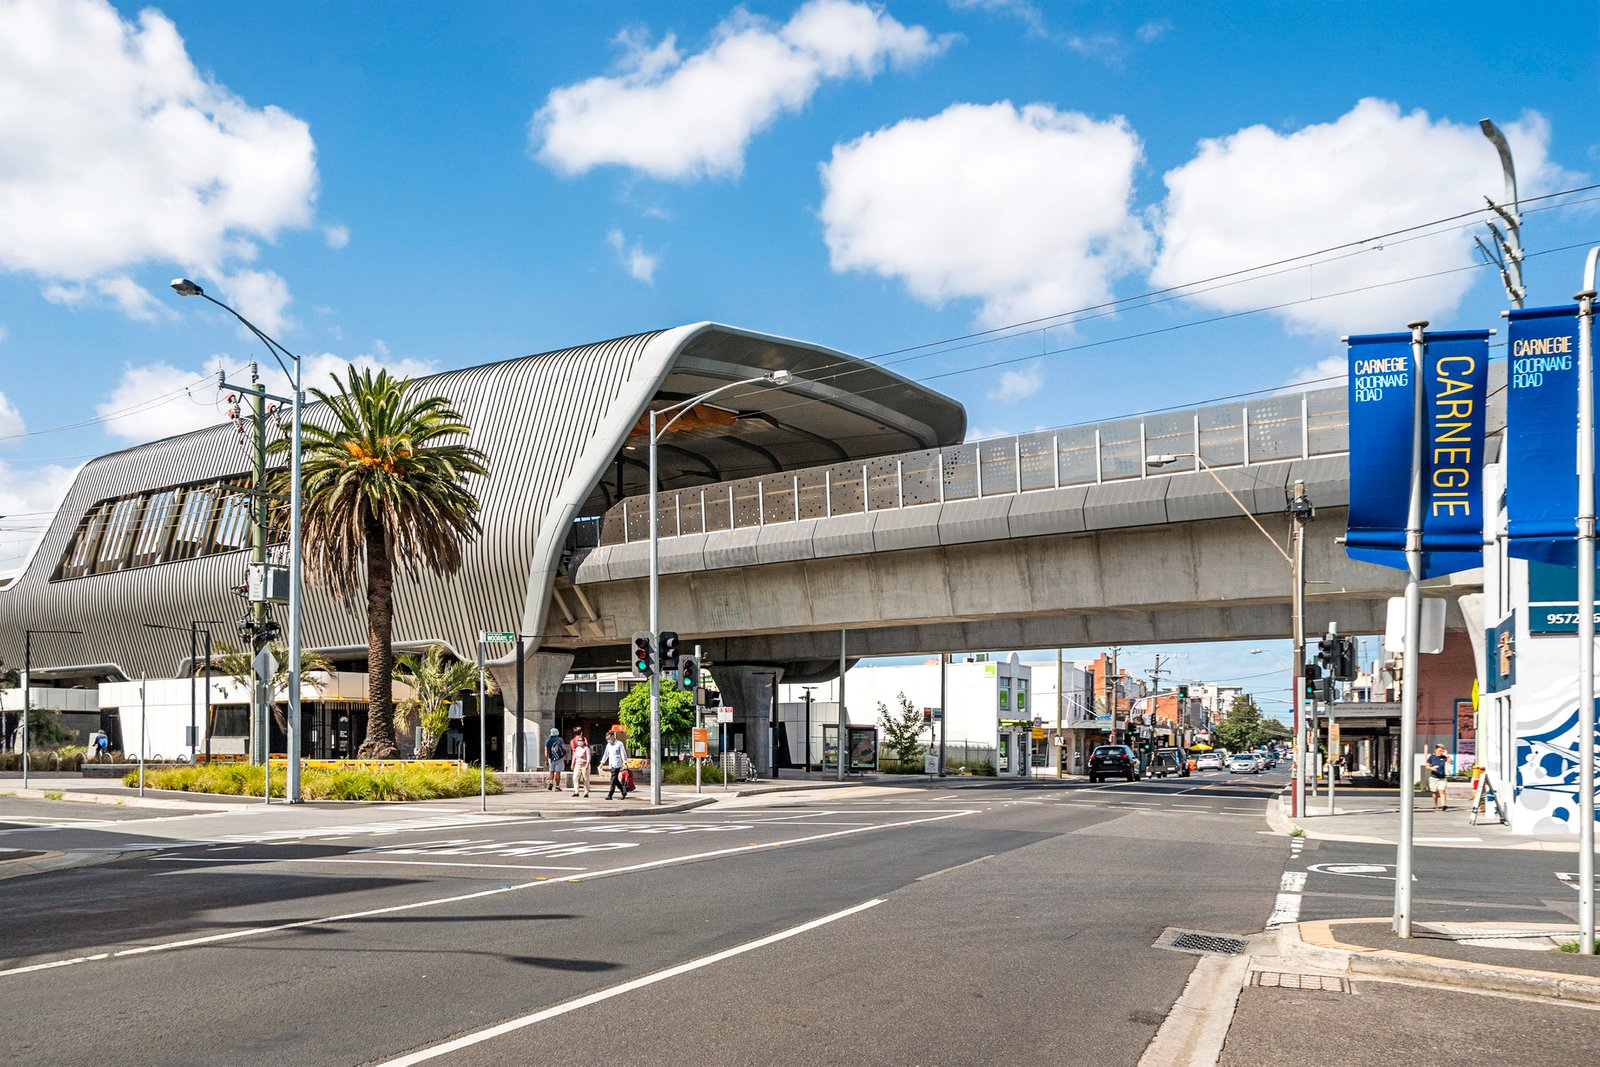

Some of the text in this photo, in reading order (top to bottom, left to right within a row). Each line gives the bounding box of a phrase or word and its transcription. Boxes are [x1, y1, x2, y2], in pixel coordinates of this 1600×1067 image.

[1513, 335, 1573, 357] CARNEGIE
[1354, 356, 1408, 375] CARNEGIE
[1513, 355, 1572, 374] KOORNANG
[1355, 373, 1408, 390] KOORNANG
[1513, 372, 1543, 389] ROAD
[1355, 387, 1383, 403] ROAD
[1432, 355, 1475, 518] CARNEGIE
[1546, 613, 1580, 625] 9572
[347, 838, 640, 858] CLEAR
